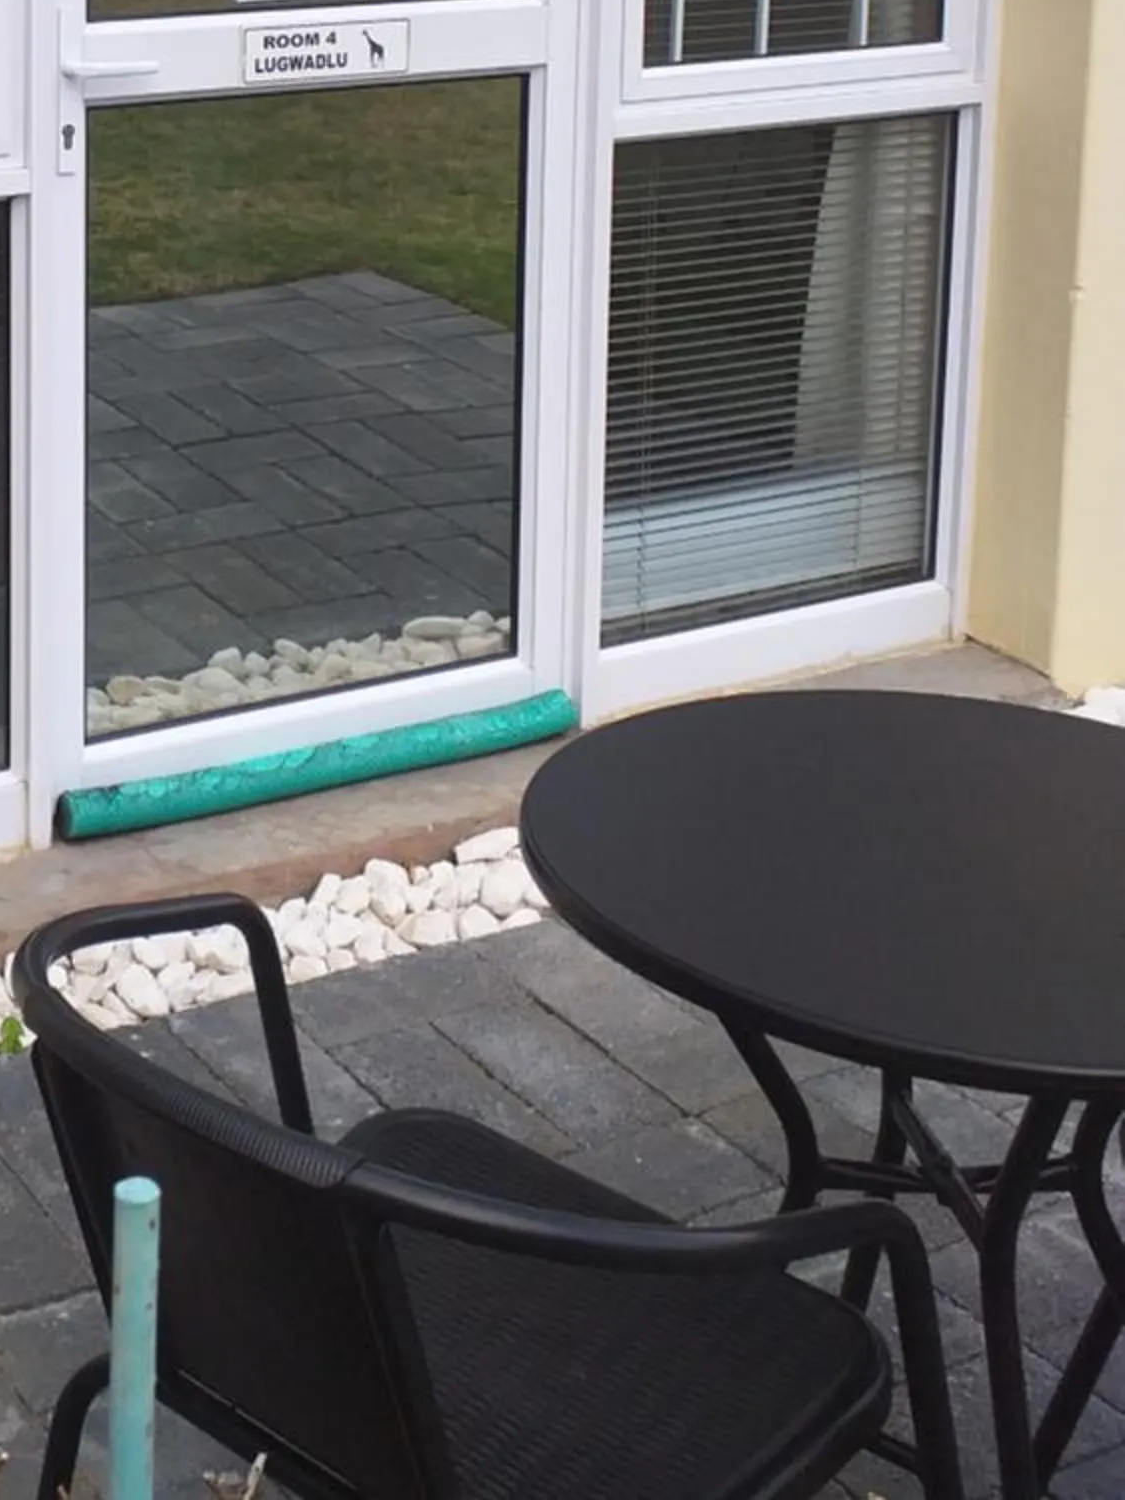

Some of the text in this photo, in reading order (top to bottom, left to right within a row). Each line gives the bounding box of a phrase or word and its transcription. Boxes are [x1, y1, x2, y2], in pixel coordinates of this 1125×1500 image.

[263, 31, 337, 49] ROOM 4
[254, 52, 348, 73] LUGWADLU
